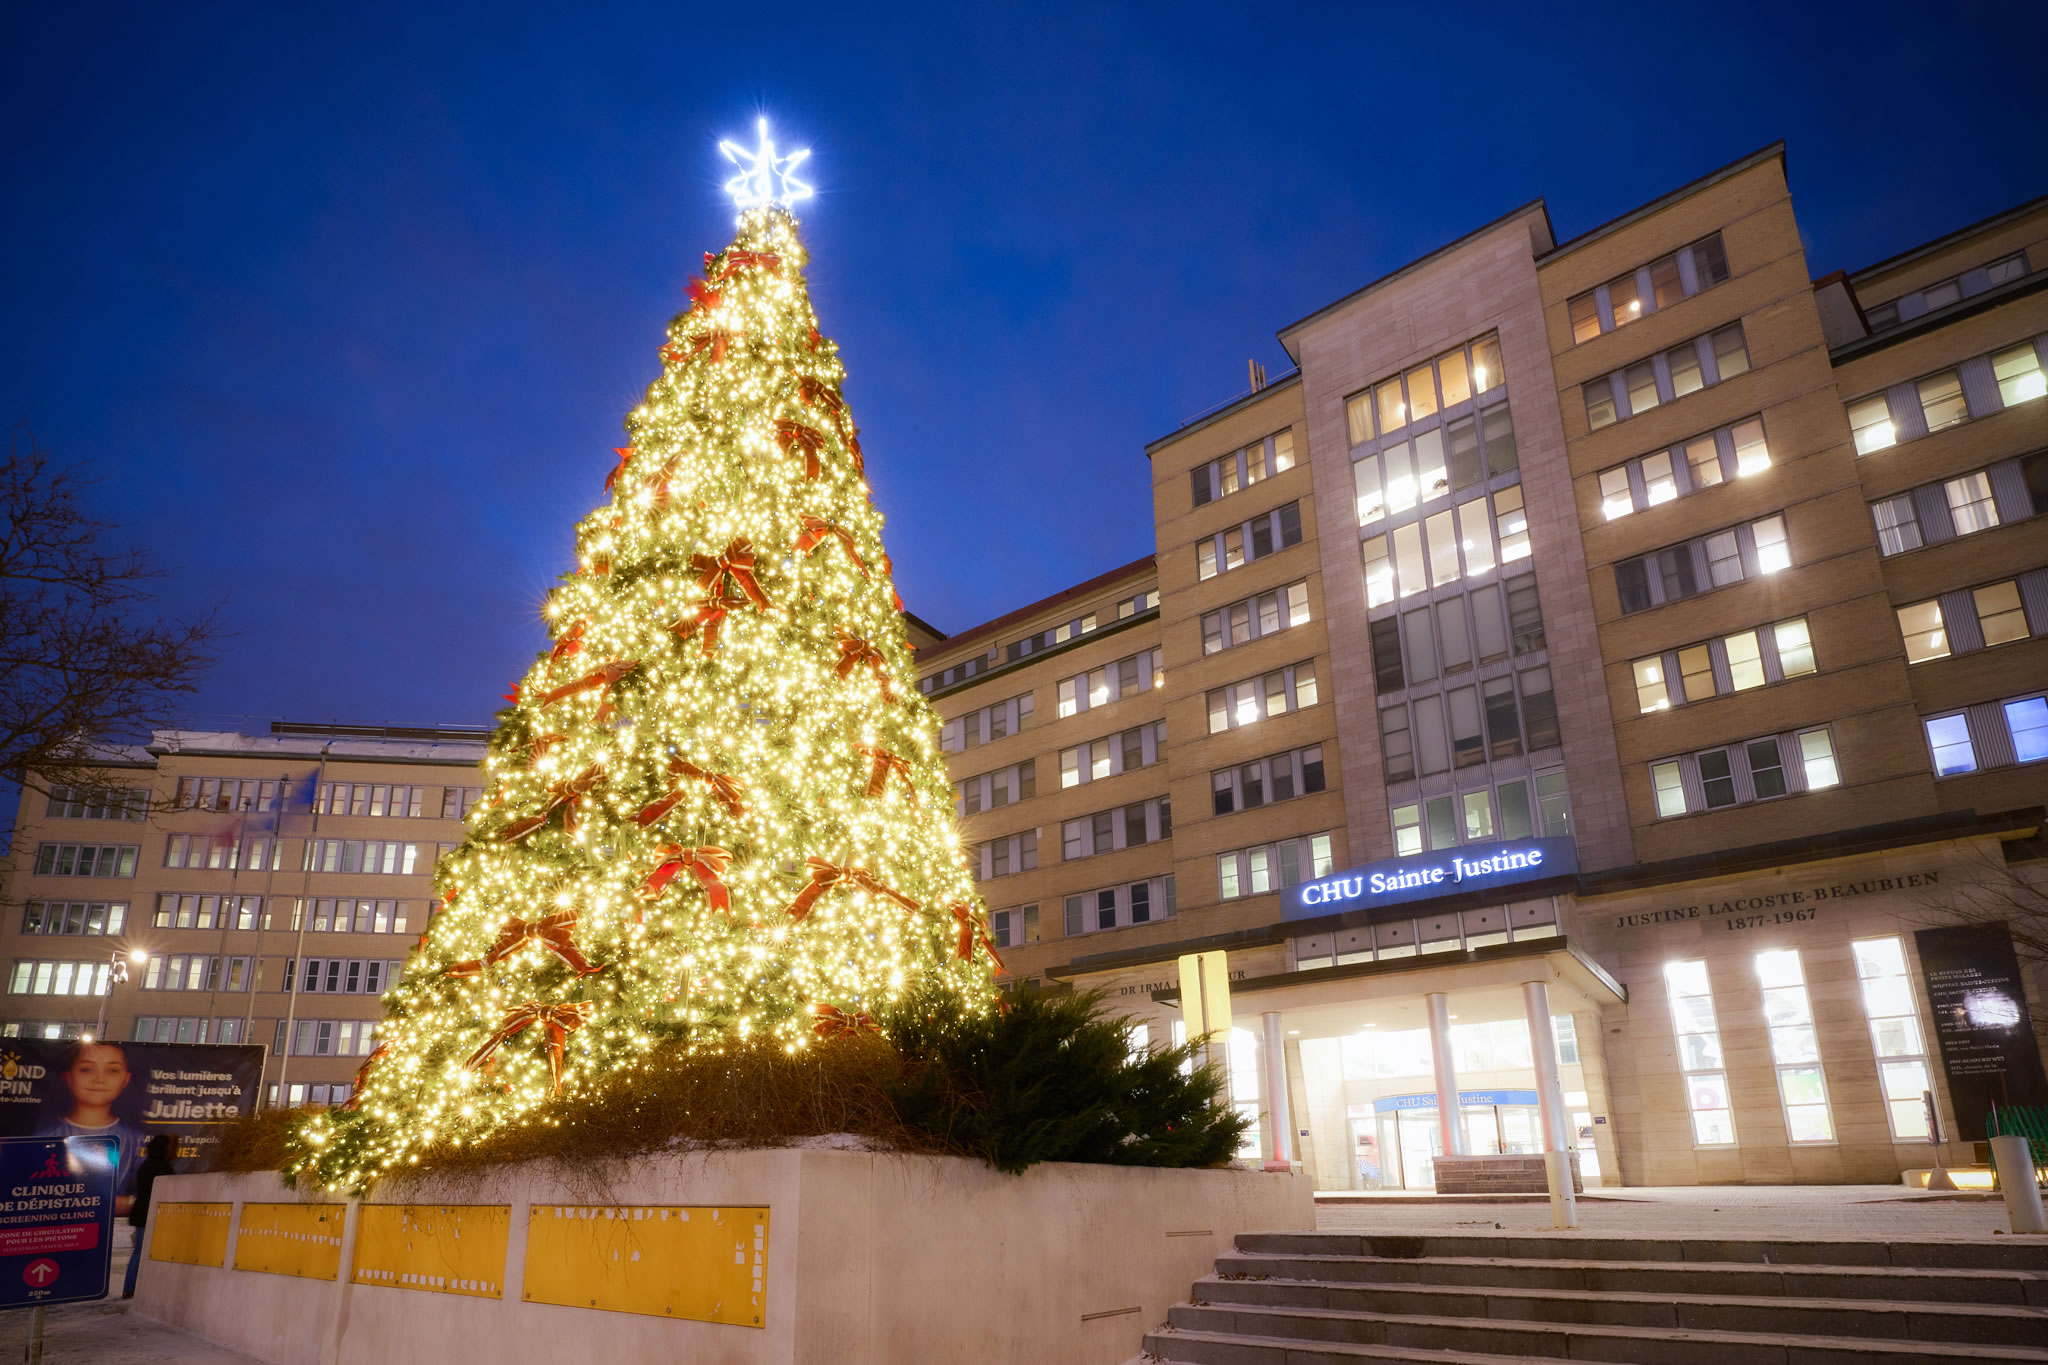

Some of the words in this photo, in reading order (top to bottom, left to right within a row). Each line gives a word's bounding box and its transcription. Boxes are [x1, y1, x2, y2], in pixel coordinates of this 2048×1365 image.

[1302, 877, 1363, 905] CHU
[1370, 849, 1543, 894] Sainte-Justine
[1616, 906, 1700, 928] JUSTINE
[1708, 871, 1940, 916] LACOSTE-BEAUBIEN
[1727, 908, 1817, 931] 1877-1967
[1120, 986, 1136, 996] DR
[1140, 981, 1171, 993] IRMA
[151, 1069, 177, 1080] Vos
[177, 1070, 233, 1081] lumières
[147, 1083, 197, 1095] brillent
[197, 1084, 242, 1097] jusqu'à
[143, 1099, 239, 1119] Juliette
[1396, 1097, 1420, 1108] CHU
[11, 1183, 85, 1197] CLINIQUE
[17, 1196, 101, 1211] DÉPISTAGE
[60, 1211, 96, 1220] CLINIC
[33, 1227, 85, 1236] CIRCULATION
[44, 1234, 78, 1243] PIÉTONS
